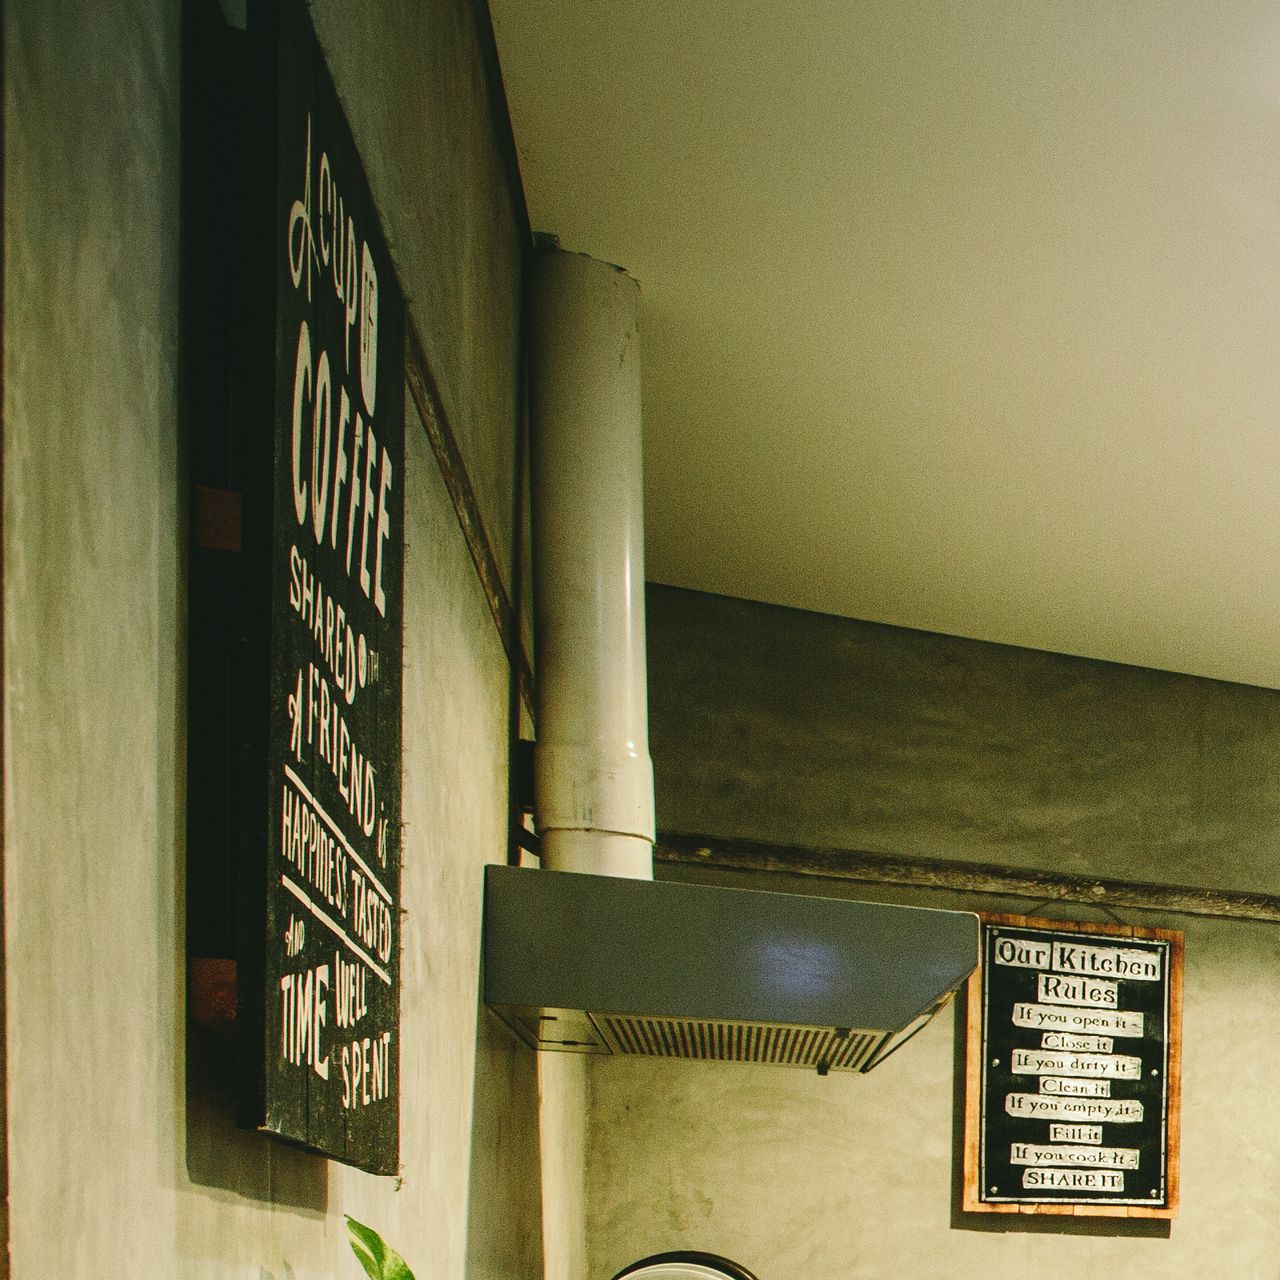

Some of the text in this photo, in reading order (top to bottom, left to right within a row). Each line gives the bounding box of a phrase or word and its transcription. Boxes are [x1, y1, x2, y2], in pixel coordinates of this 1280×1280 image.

[292, 320, 392, 618] COFFEE
[290, 544, 356, 705] SHARED
[307, 662, 376, 837] FRIEND
[351, 869, 392, 964] TASTED
[1000, 940, 1157, 977] Our Kitchen
[1043, 976, 1116, 1004] Rules
[281, 950, 368, 1081] TIME WELL
[1019, 1006, 1032, 1019] If
[1038, 1012, 1067, 1026] you
[1072, 1016, 1109, 1029] open
[1044, 1034, 1107, 1050] Close it
[341, 1031, 391, 1110] SPENT
[1017, 1053, 1030, 1066] If
[1036, 1060, 1064, 1071] you
[1070, 1058, 1109, 1074] dirty
[1042, 1079, 1088, 1095] Clean
[1010, 1096, 1024, 1109] If
[1029, 1101, 1058, 1114] you
[1064, 1103, 1112, 1117] empty
[1053, 1127, 1100, 1140] Fill it
[1015, 1146, 1029, 1159] If
[1034, 1152, 1063, 1164] you
[1068, 1151, 1107, 1163] cook
[1027, 1172, 1119, 1188] SHARE IT
